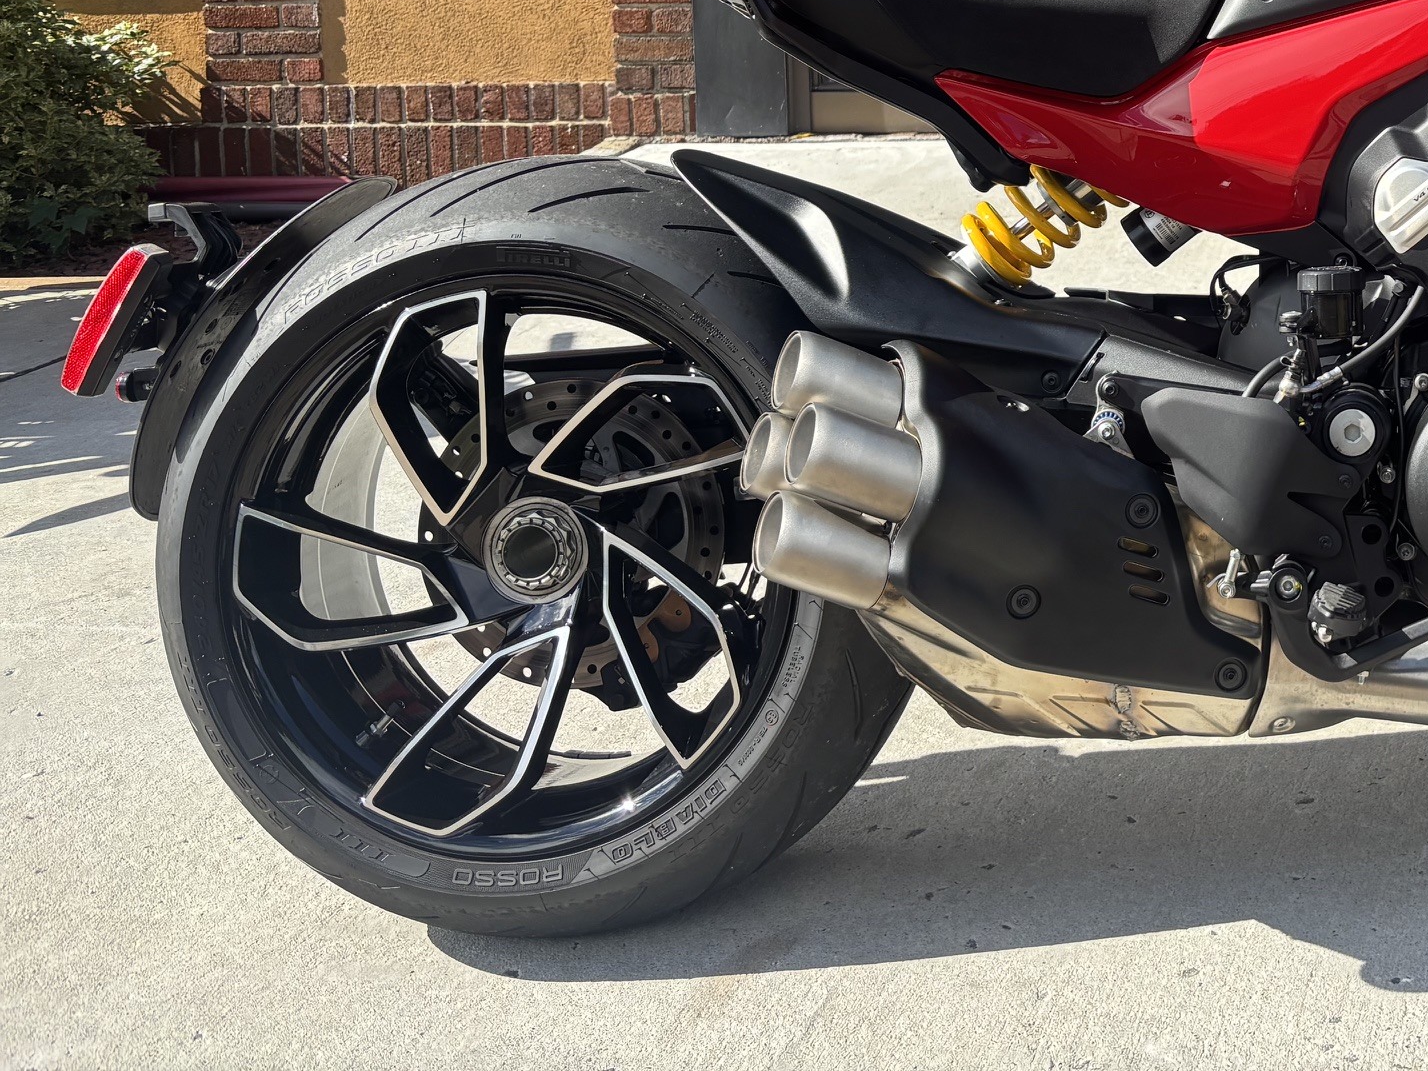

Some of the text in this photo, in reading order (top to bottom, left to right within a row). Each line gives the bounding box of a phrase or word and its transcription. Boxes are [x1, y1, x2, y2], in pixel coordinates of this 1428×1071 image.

[1413, 191, 1426, 202] V4
[611, 777, 727, 864] DIABLO
[451, 862, 565, 889] ROSSO
